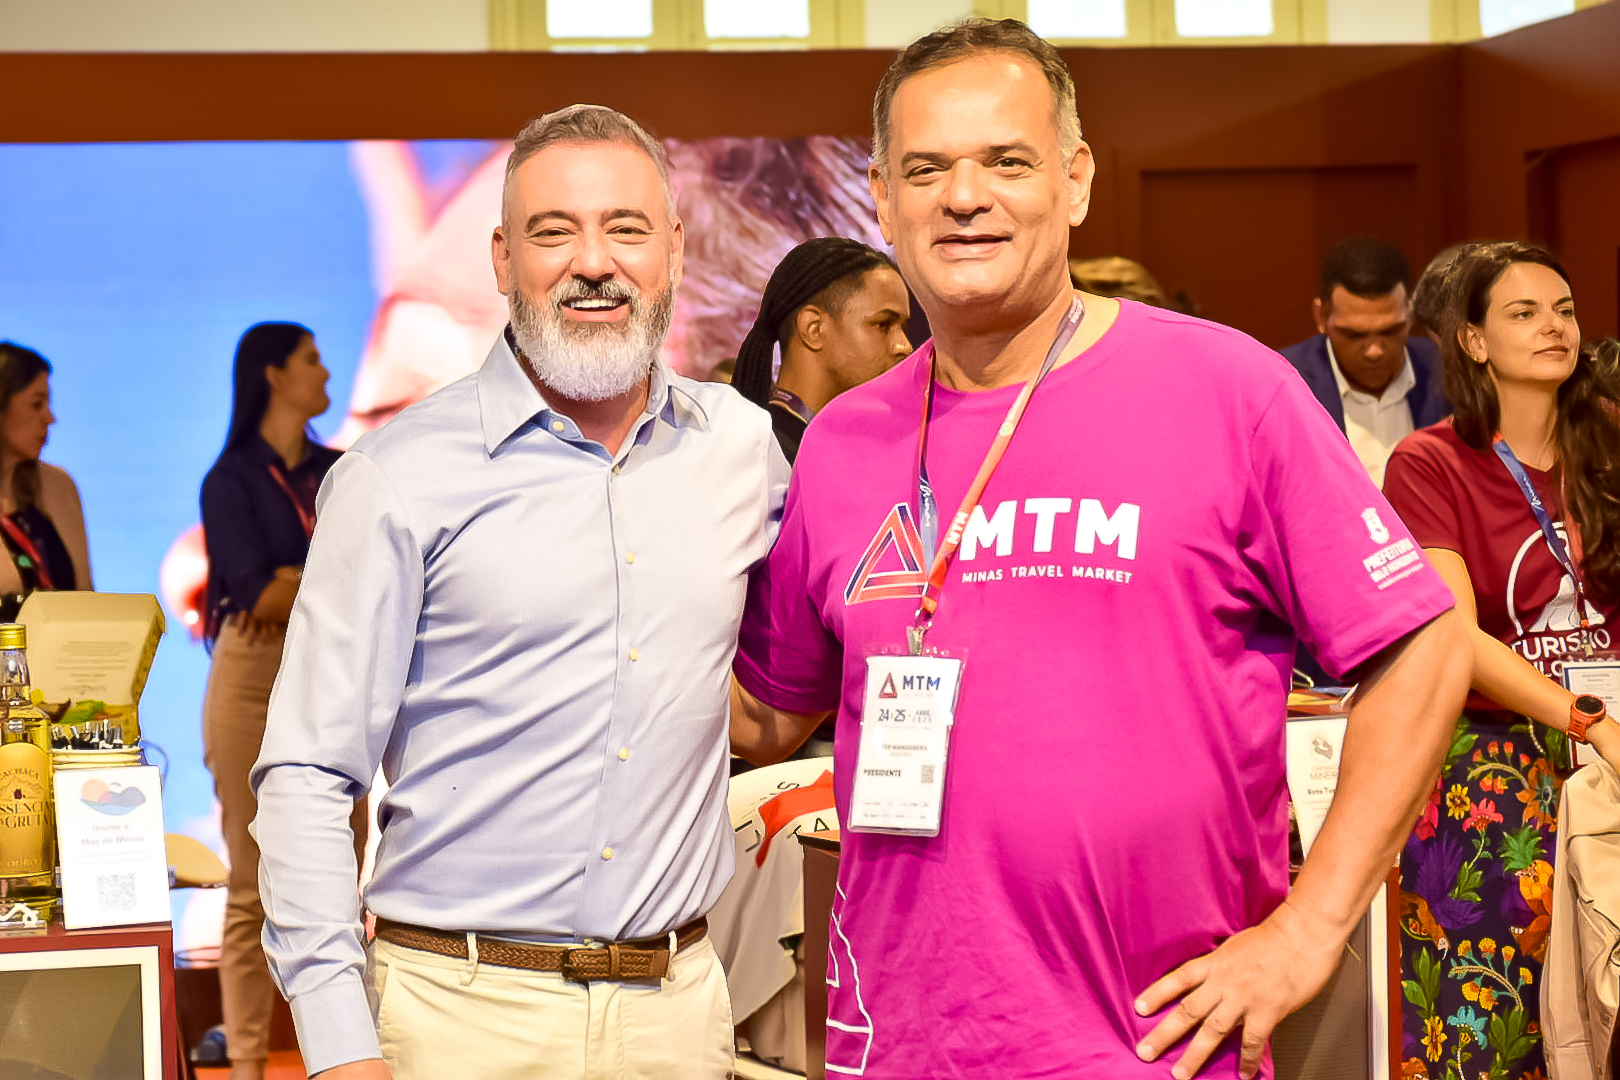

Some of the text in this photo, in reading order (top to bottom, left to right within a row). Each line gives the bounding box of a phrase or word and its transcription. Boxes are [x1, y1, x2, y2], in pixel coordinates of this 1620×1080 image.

[958, 497, 1140, 561] MTM
[961, 564, 1133, 584] MINAS TRAVEL MARKET
[902, 674, 941, 691] MTM
[894, 708, 907, 723] 25
[863, 768, 902, 778] PRESIDENTE
